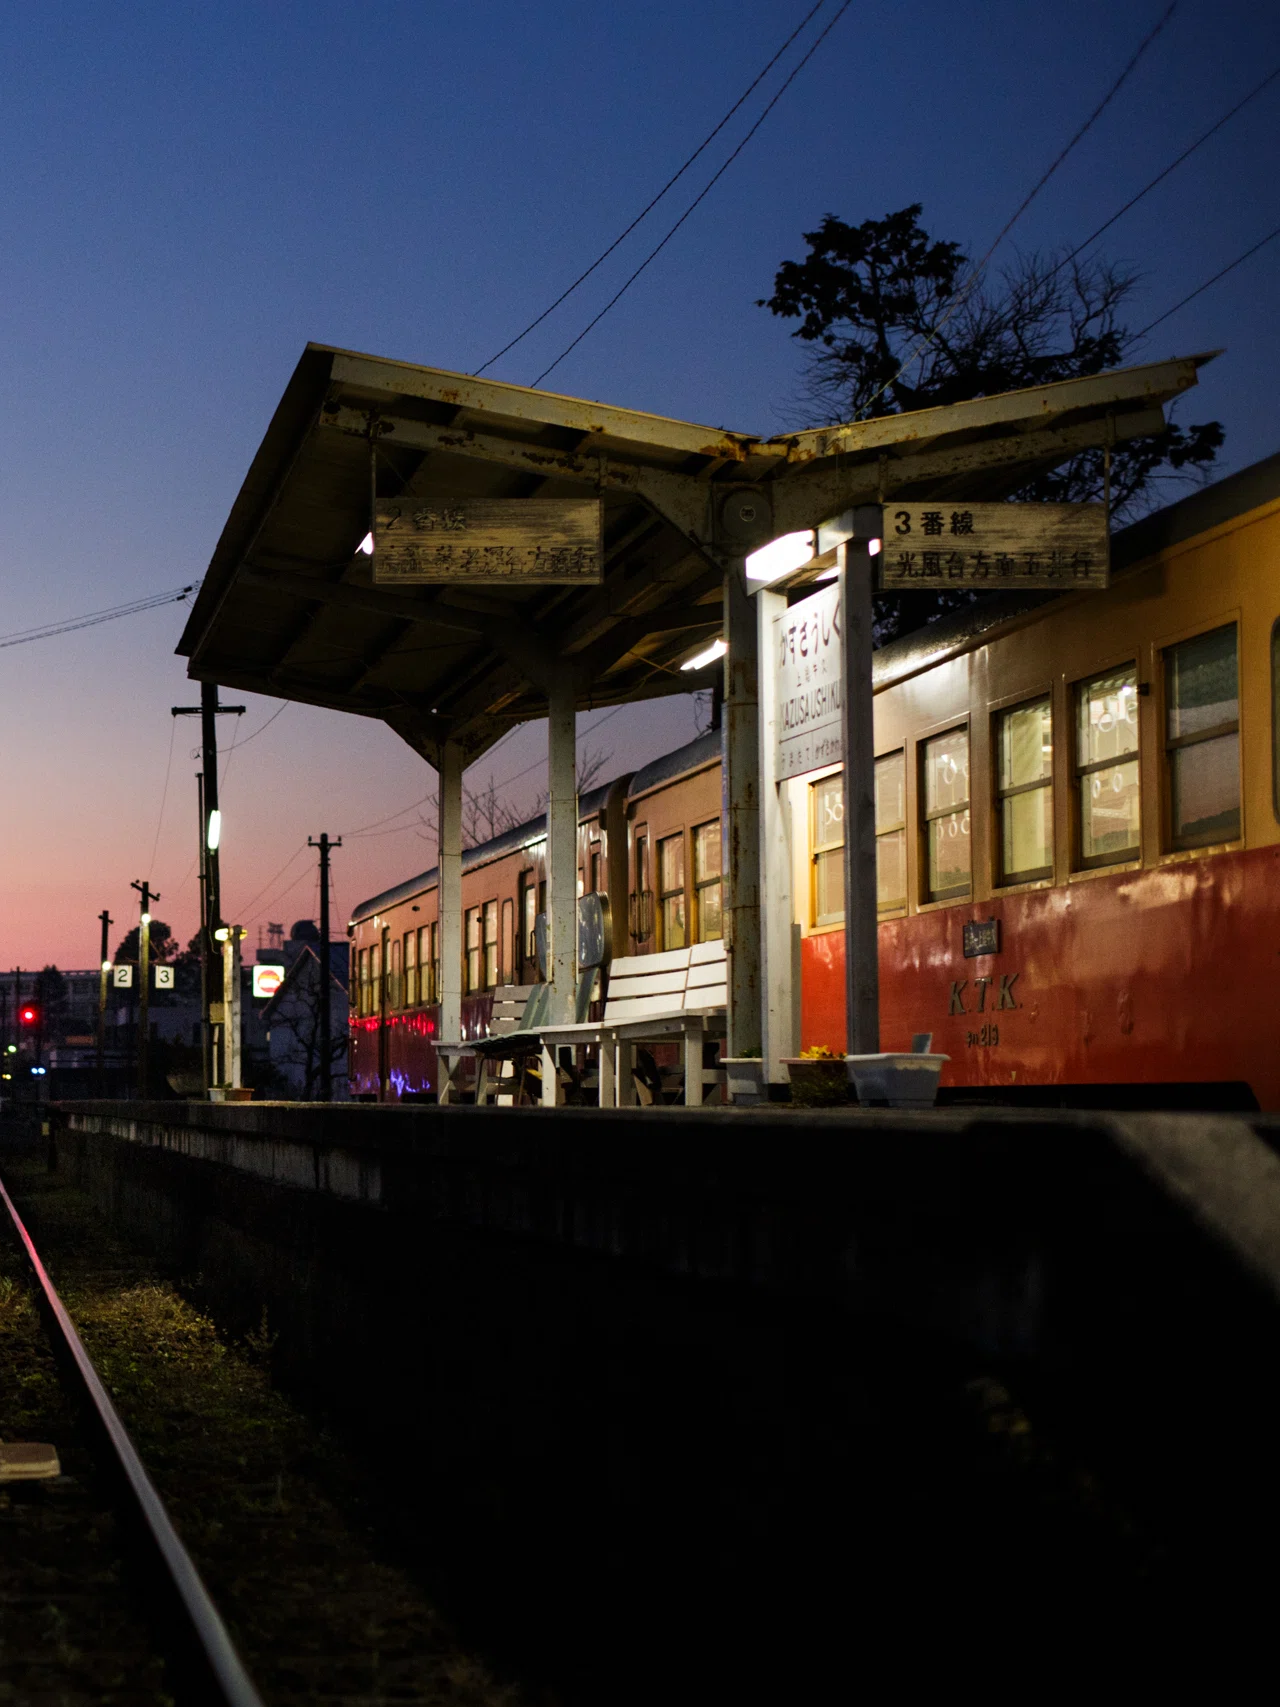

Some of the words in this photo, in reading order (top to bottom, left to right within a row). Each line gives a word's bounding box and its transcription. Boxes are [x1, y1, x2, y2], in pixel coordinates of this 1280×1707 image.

[894, 510, 975, 536] 3番線
[118, 969, 128, 982] 2
[160, 970, 170, 983] 3
